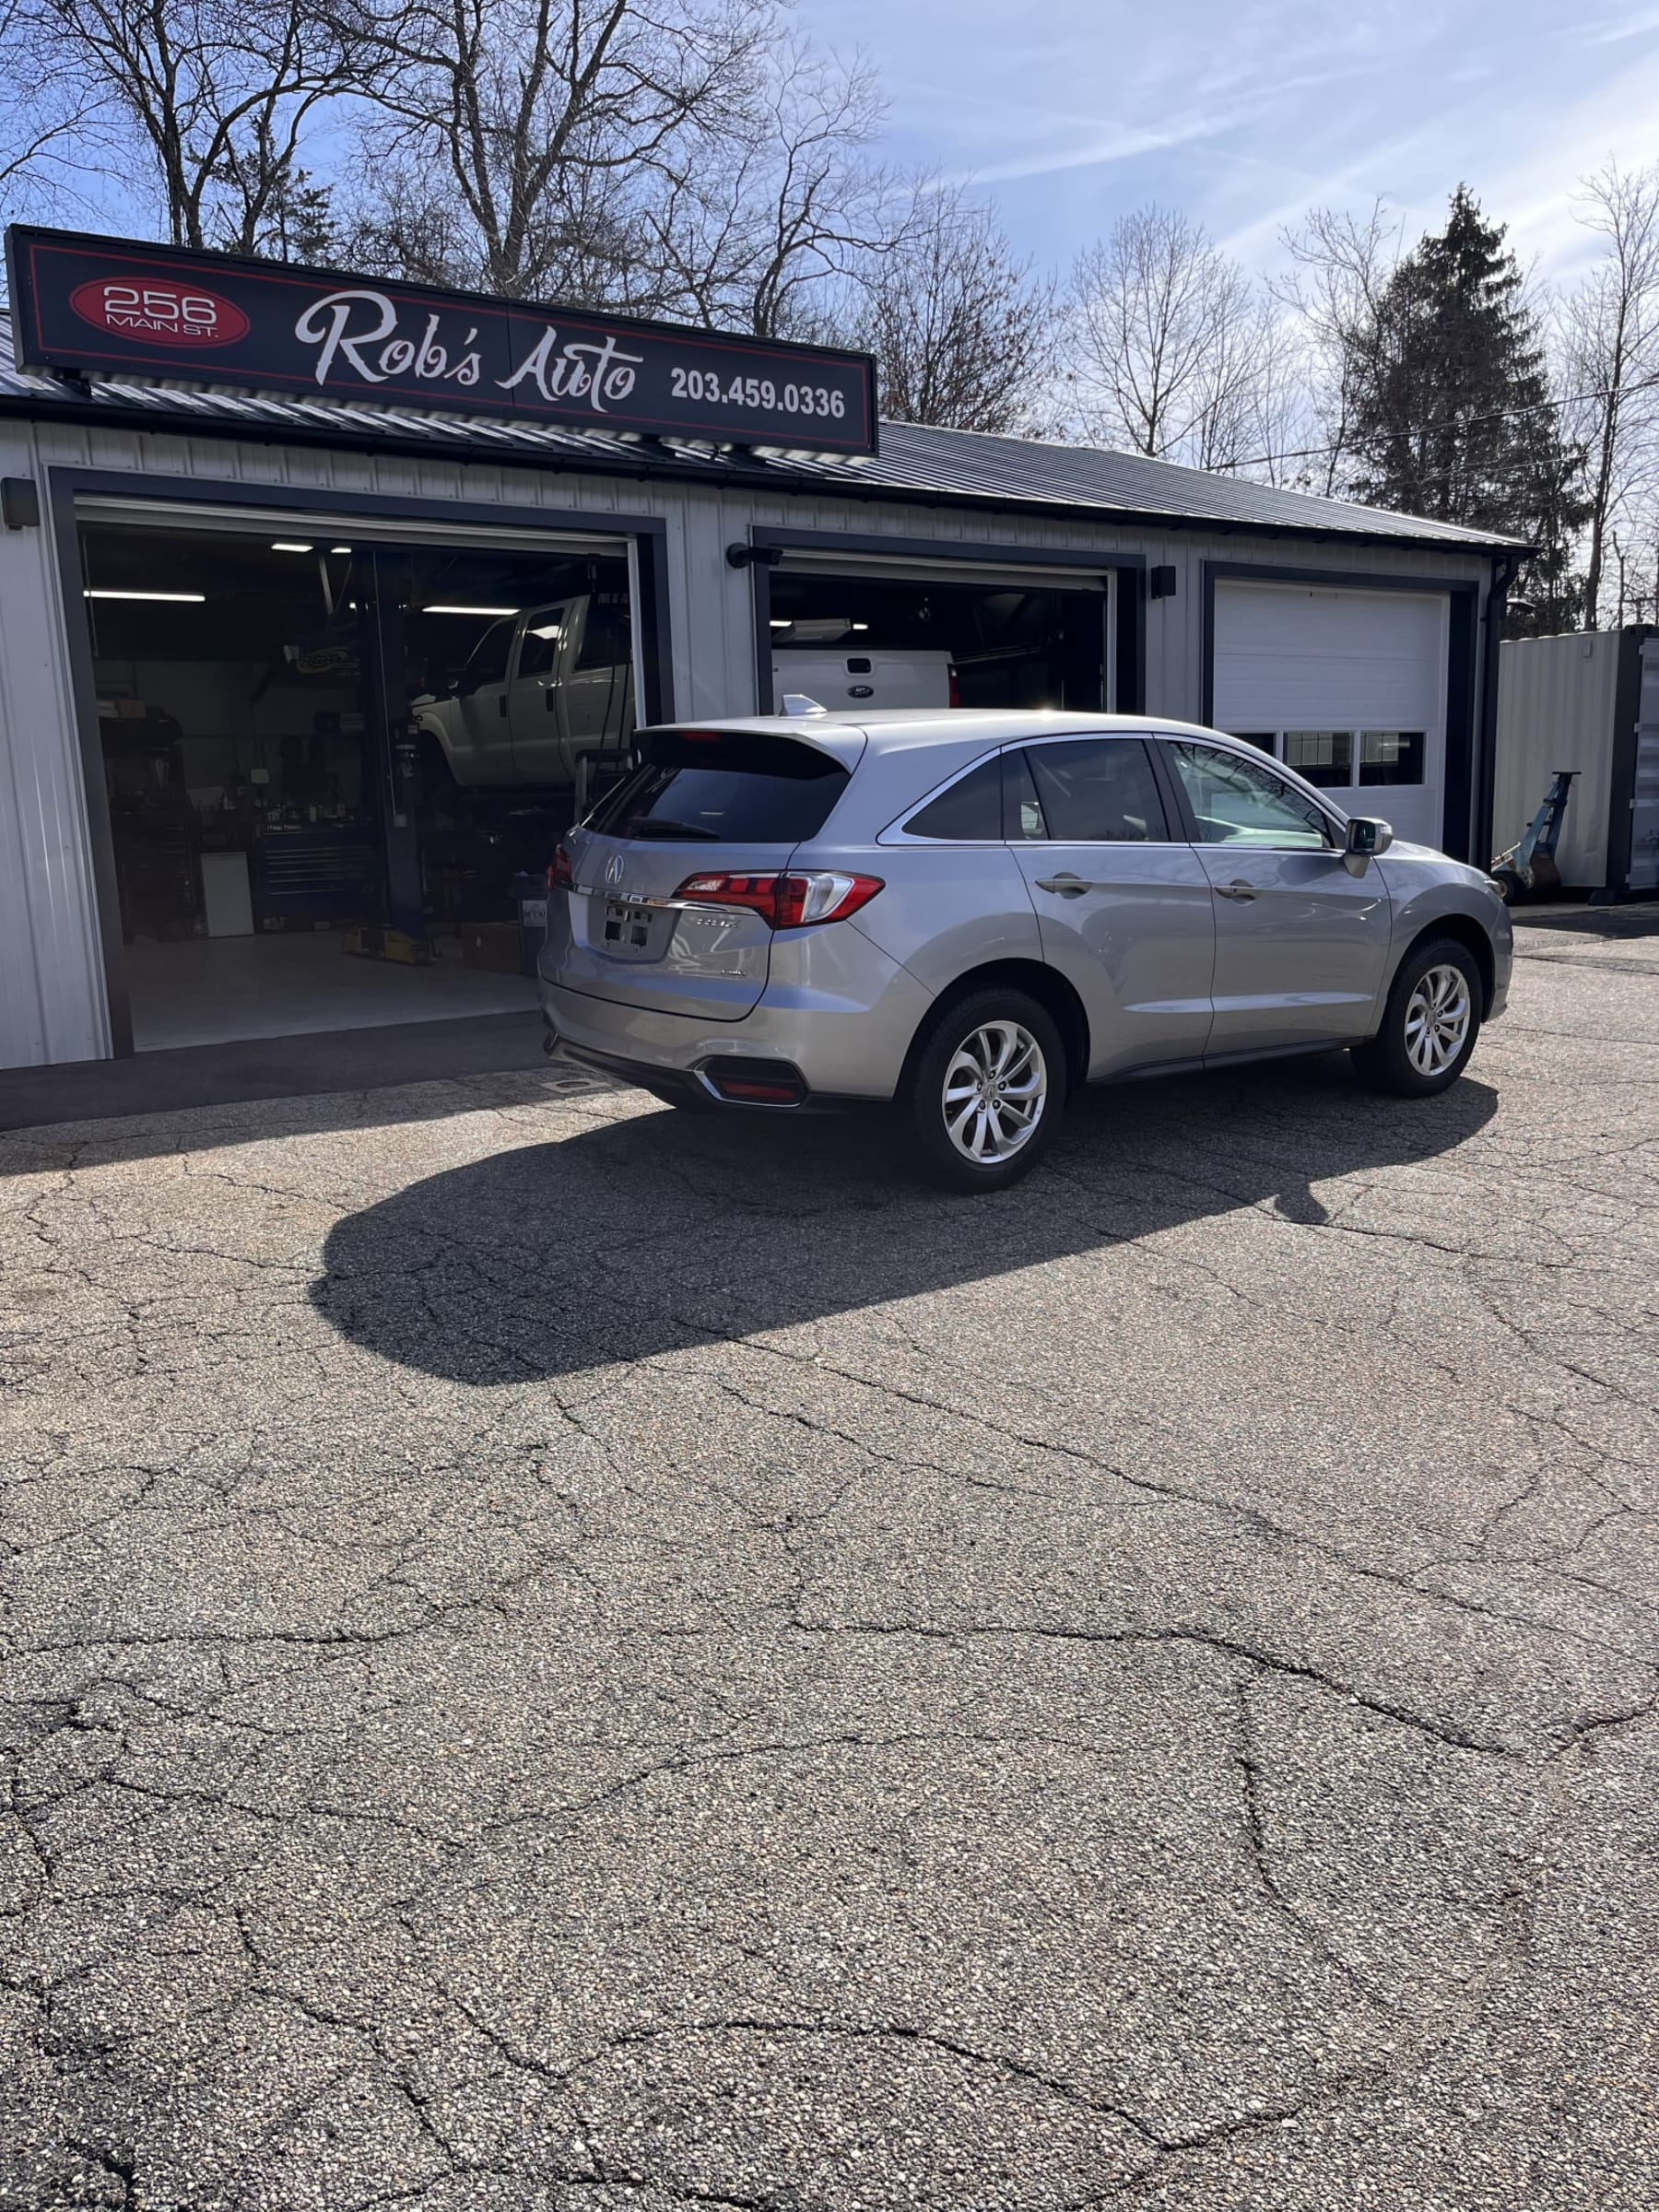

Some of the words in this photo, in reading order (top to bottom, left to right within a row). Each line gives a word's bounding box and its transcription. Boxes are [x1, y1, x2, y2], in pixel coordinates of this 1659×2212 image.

[104, 287, 216, 324] 256
[106, 314, 177, 333] MAIN
[183, 326, 219, 338] ST.
[295, 290, 481, 385] Rob's
[494, 326, 643, 412] Auto
[671, 368, 844, 418] 203.459.0336
